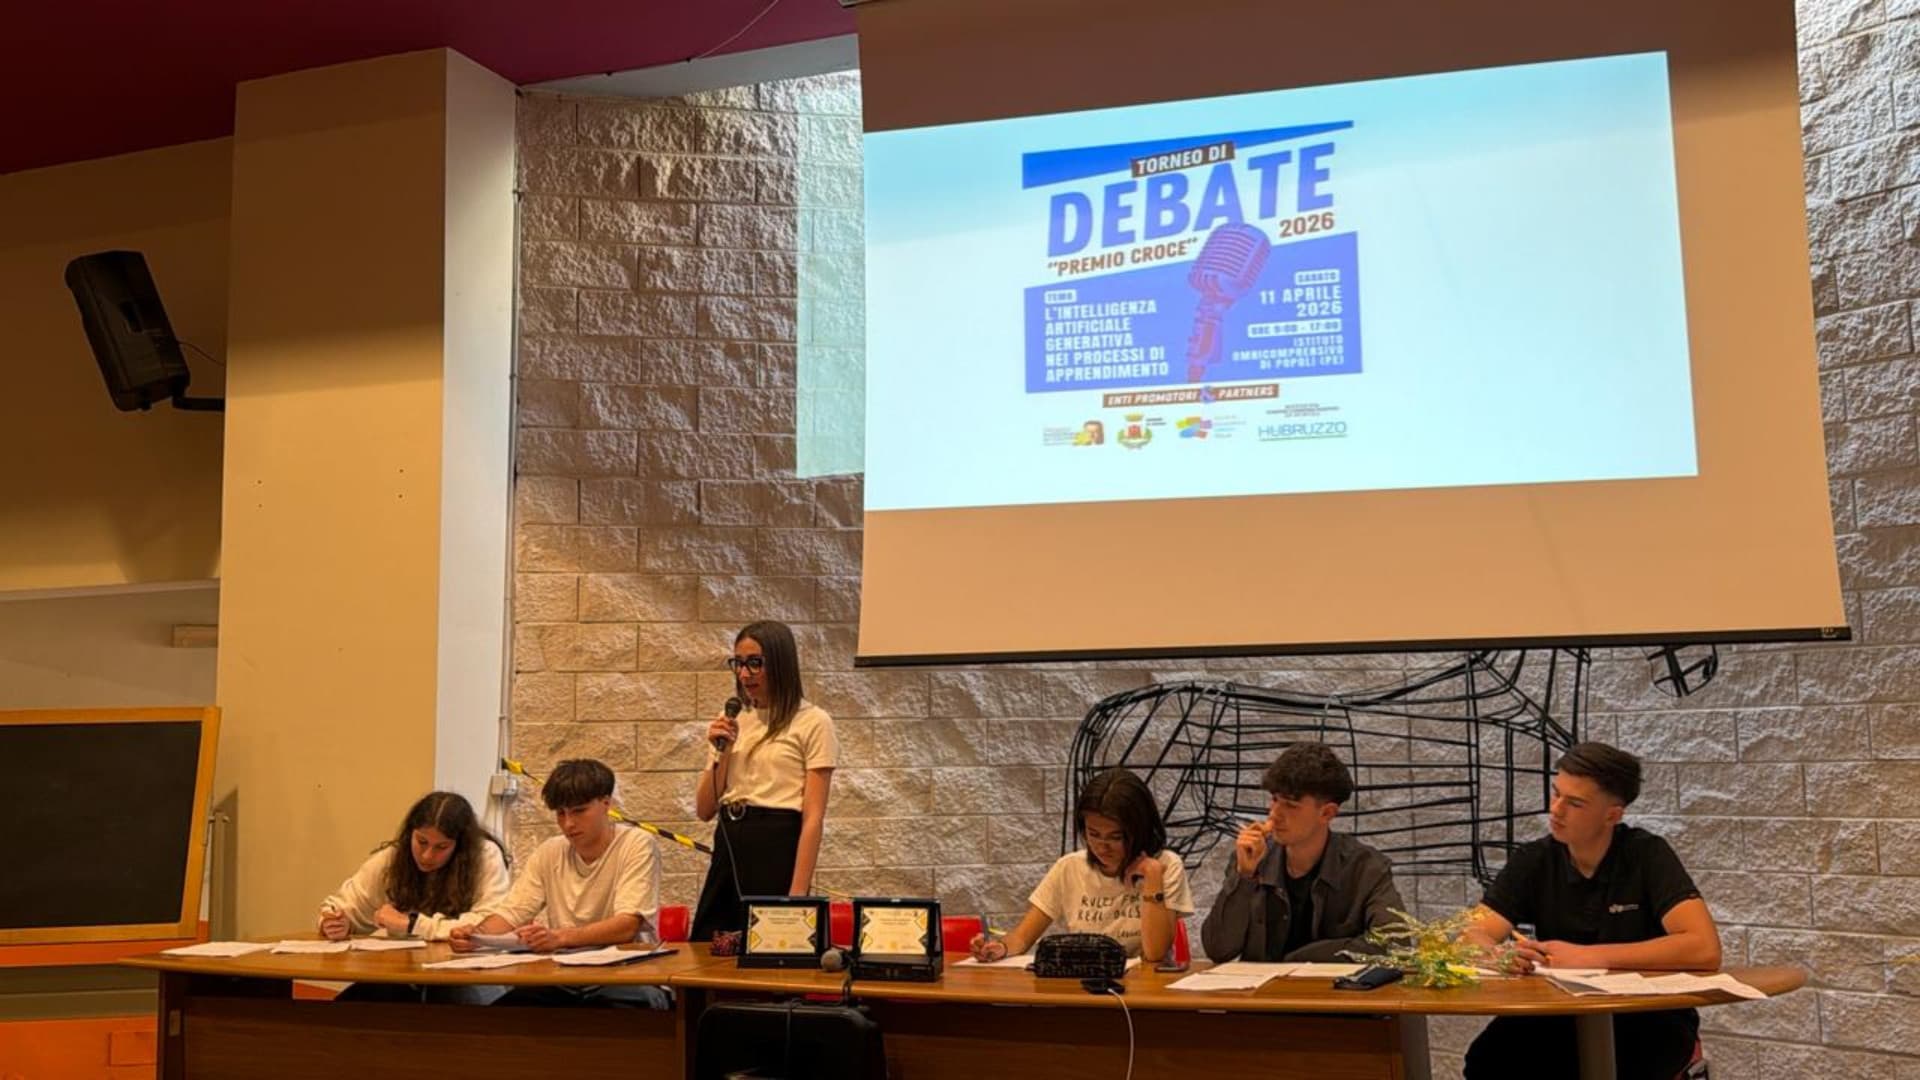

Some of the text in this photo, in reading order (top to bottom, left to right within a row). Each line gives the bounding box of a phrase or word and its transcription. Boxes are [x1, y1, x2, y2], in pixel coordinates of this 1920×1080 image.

[1136, 144, 1227, 174] TORNEO DI
[1047, 142, 1335, 257] DEBATE
[1279, 211, 1334, 238] 2026
[1260, 285, 1342, 304] 11 APRILE
[1045, 299, 1157, 321] L'INTELLIGENZA
[1296, 301, 1342, 317] 2026
[1046, 317, 1131, 337] ARTIFICIALE
[1046, 333, 1133, 352] GENERATIVA
[1046, 346, 1165, 367] NEI PROCESSI DI
[1046, 361, 1169, 383] APPRENDIMENTO
[1108, 393, 1133, 406] ENTI
[1135, 390, 1198, 404] PROMOTORI
[1218, 385, 1274, 399] PARTNERS
